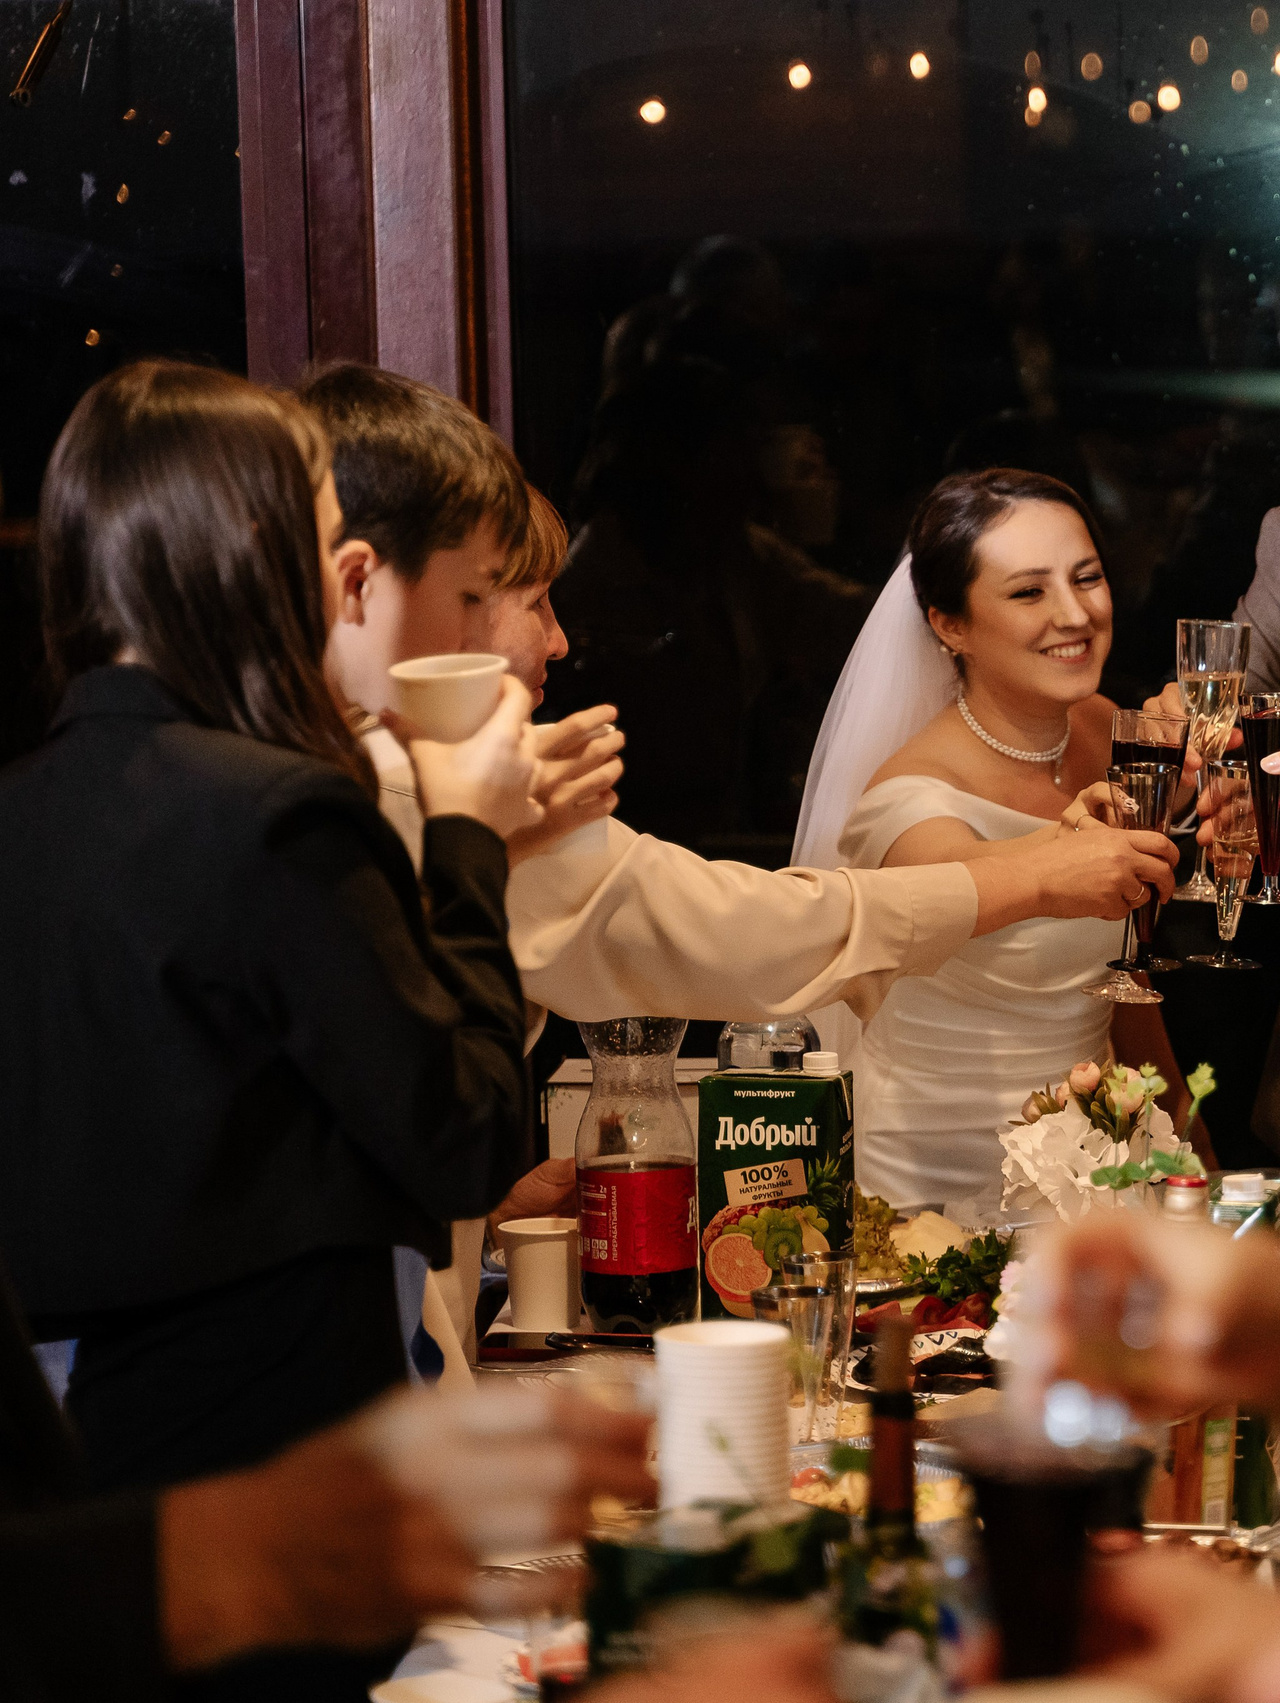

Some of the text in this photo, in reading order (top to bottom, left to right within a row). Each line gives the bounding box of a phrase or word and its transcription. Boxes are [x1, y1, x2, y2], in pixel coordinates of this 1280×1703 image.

[734, 1089, 796, 1098] мультифрукт
[715, 1116, 817, 1151] Добрый
[740, 1163, 789, 1185] 100%
[739, 1179, 793, 1194] НАТУРАЛЬНЫЕ
[752, 1190, 784, 1201] ФРУКТЫ
